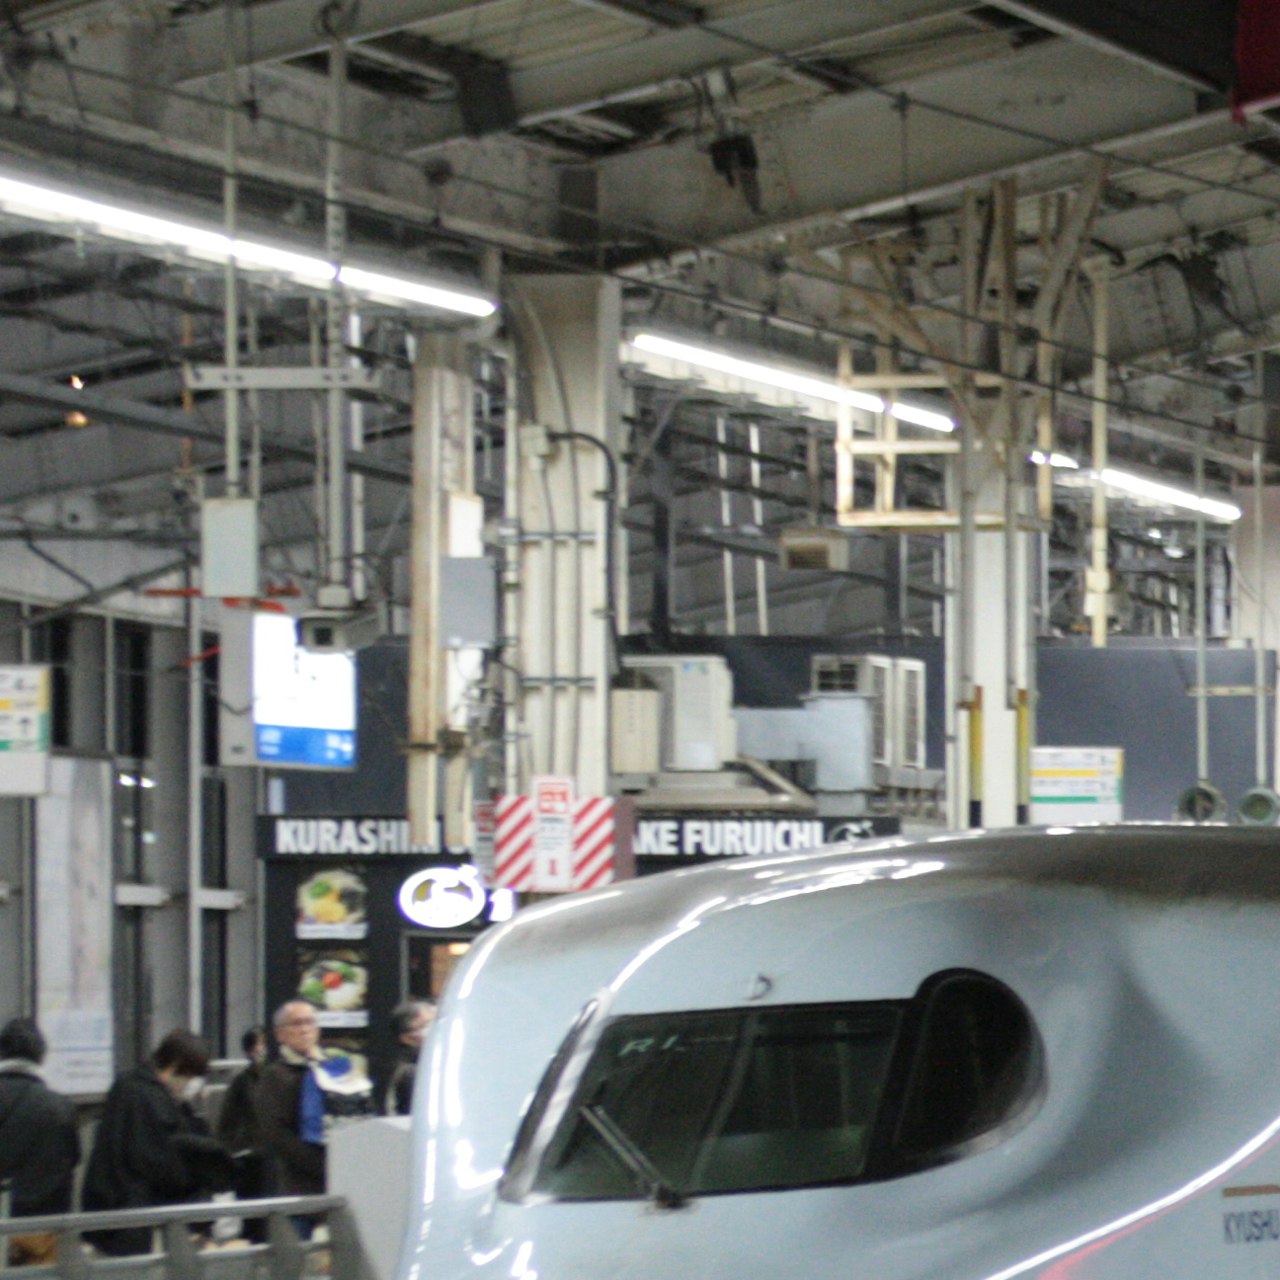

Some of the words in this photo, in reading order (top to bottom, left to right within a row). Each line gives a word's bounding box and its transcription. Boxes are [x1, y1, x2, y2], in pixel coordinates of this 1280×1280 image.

[276, 819, 440, 854] KURASHII
[683, 820, 824, 855] FURUICHI
[1223, 1209, 1280, 1244] KYUSHU
